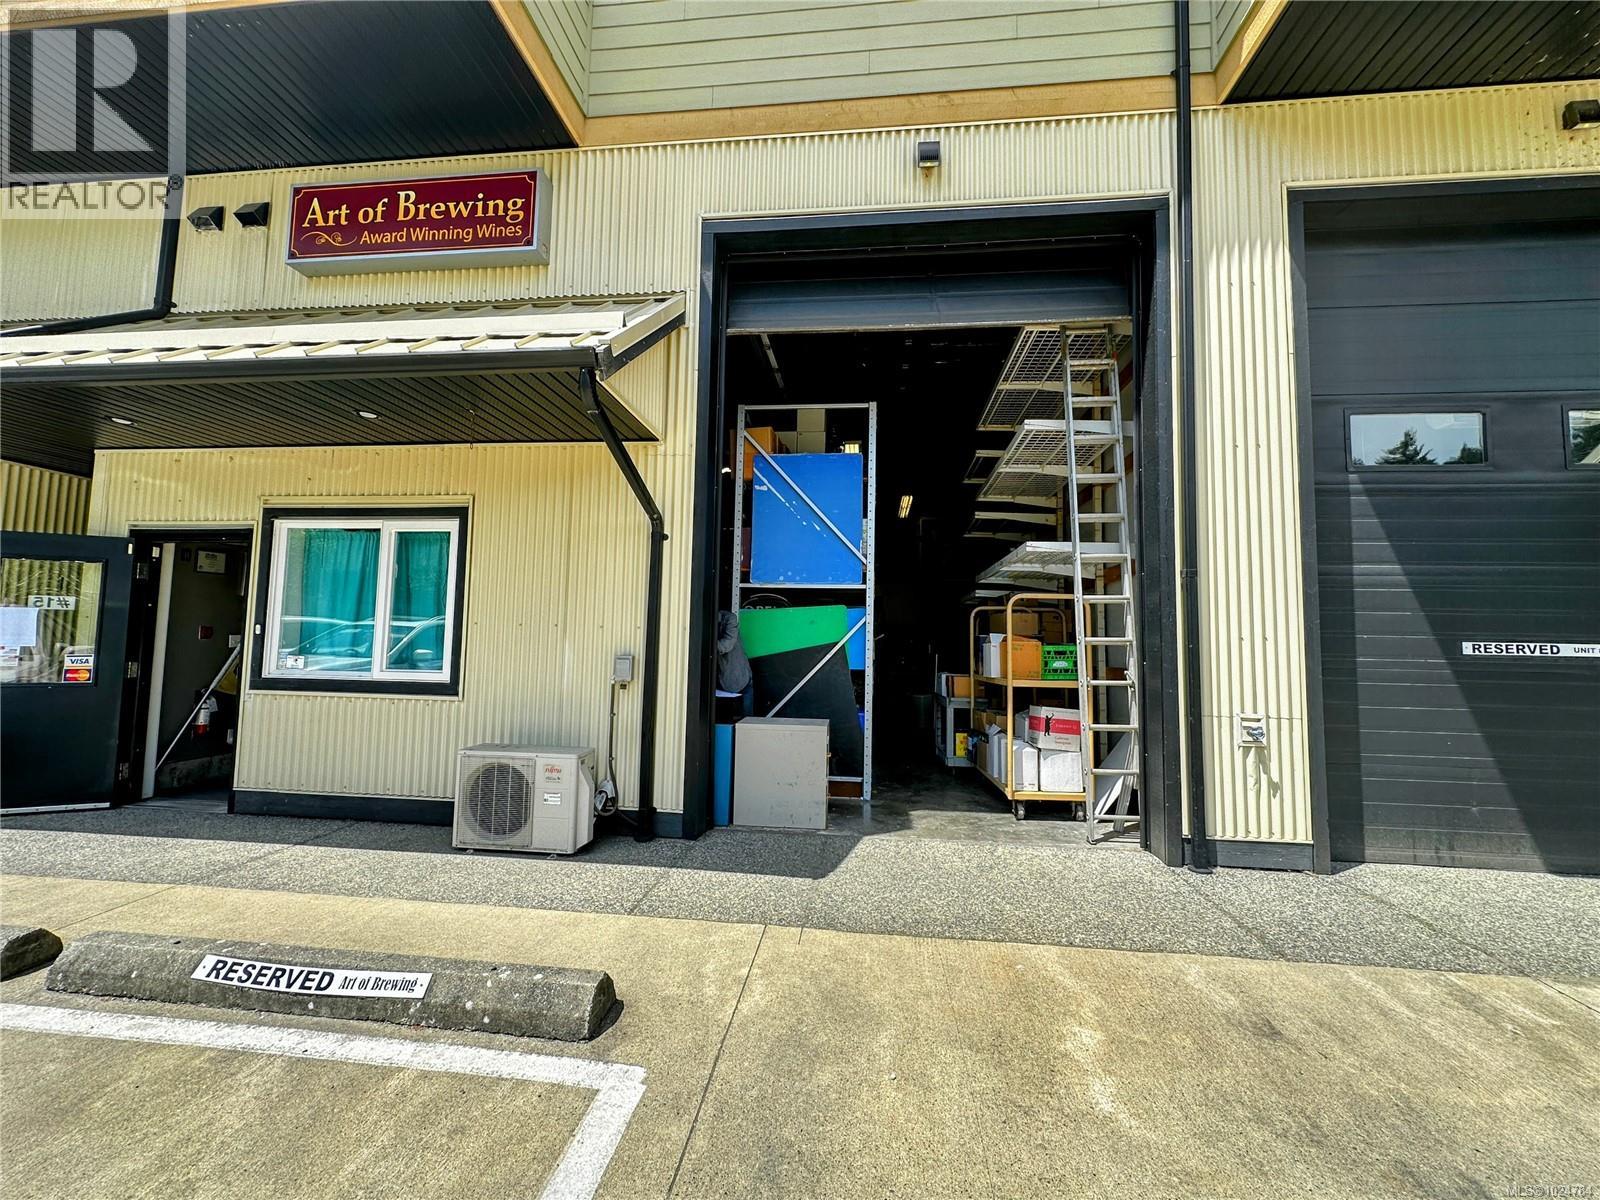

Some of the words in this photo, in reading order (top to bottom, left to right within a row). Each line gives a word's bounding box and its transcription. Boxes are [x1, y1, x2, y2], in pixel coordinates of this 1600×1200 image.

[302, 197, 350, 228] Art
[358, 197, 388, 225] of
[397, 190, 525, 224] Brewing
[360, 228, 407, 245] Award
[410, 226, 473, 243] Winning
[476, 223, 523, 238] Wines
[1471, 643, 1561, 655] RESERVED
[205, 959, 335, 992] RESERVED
[338, 975, 358, 990] Art
[358, 976, 370, 992] of
[370, 976, 418, 993] Brewing
